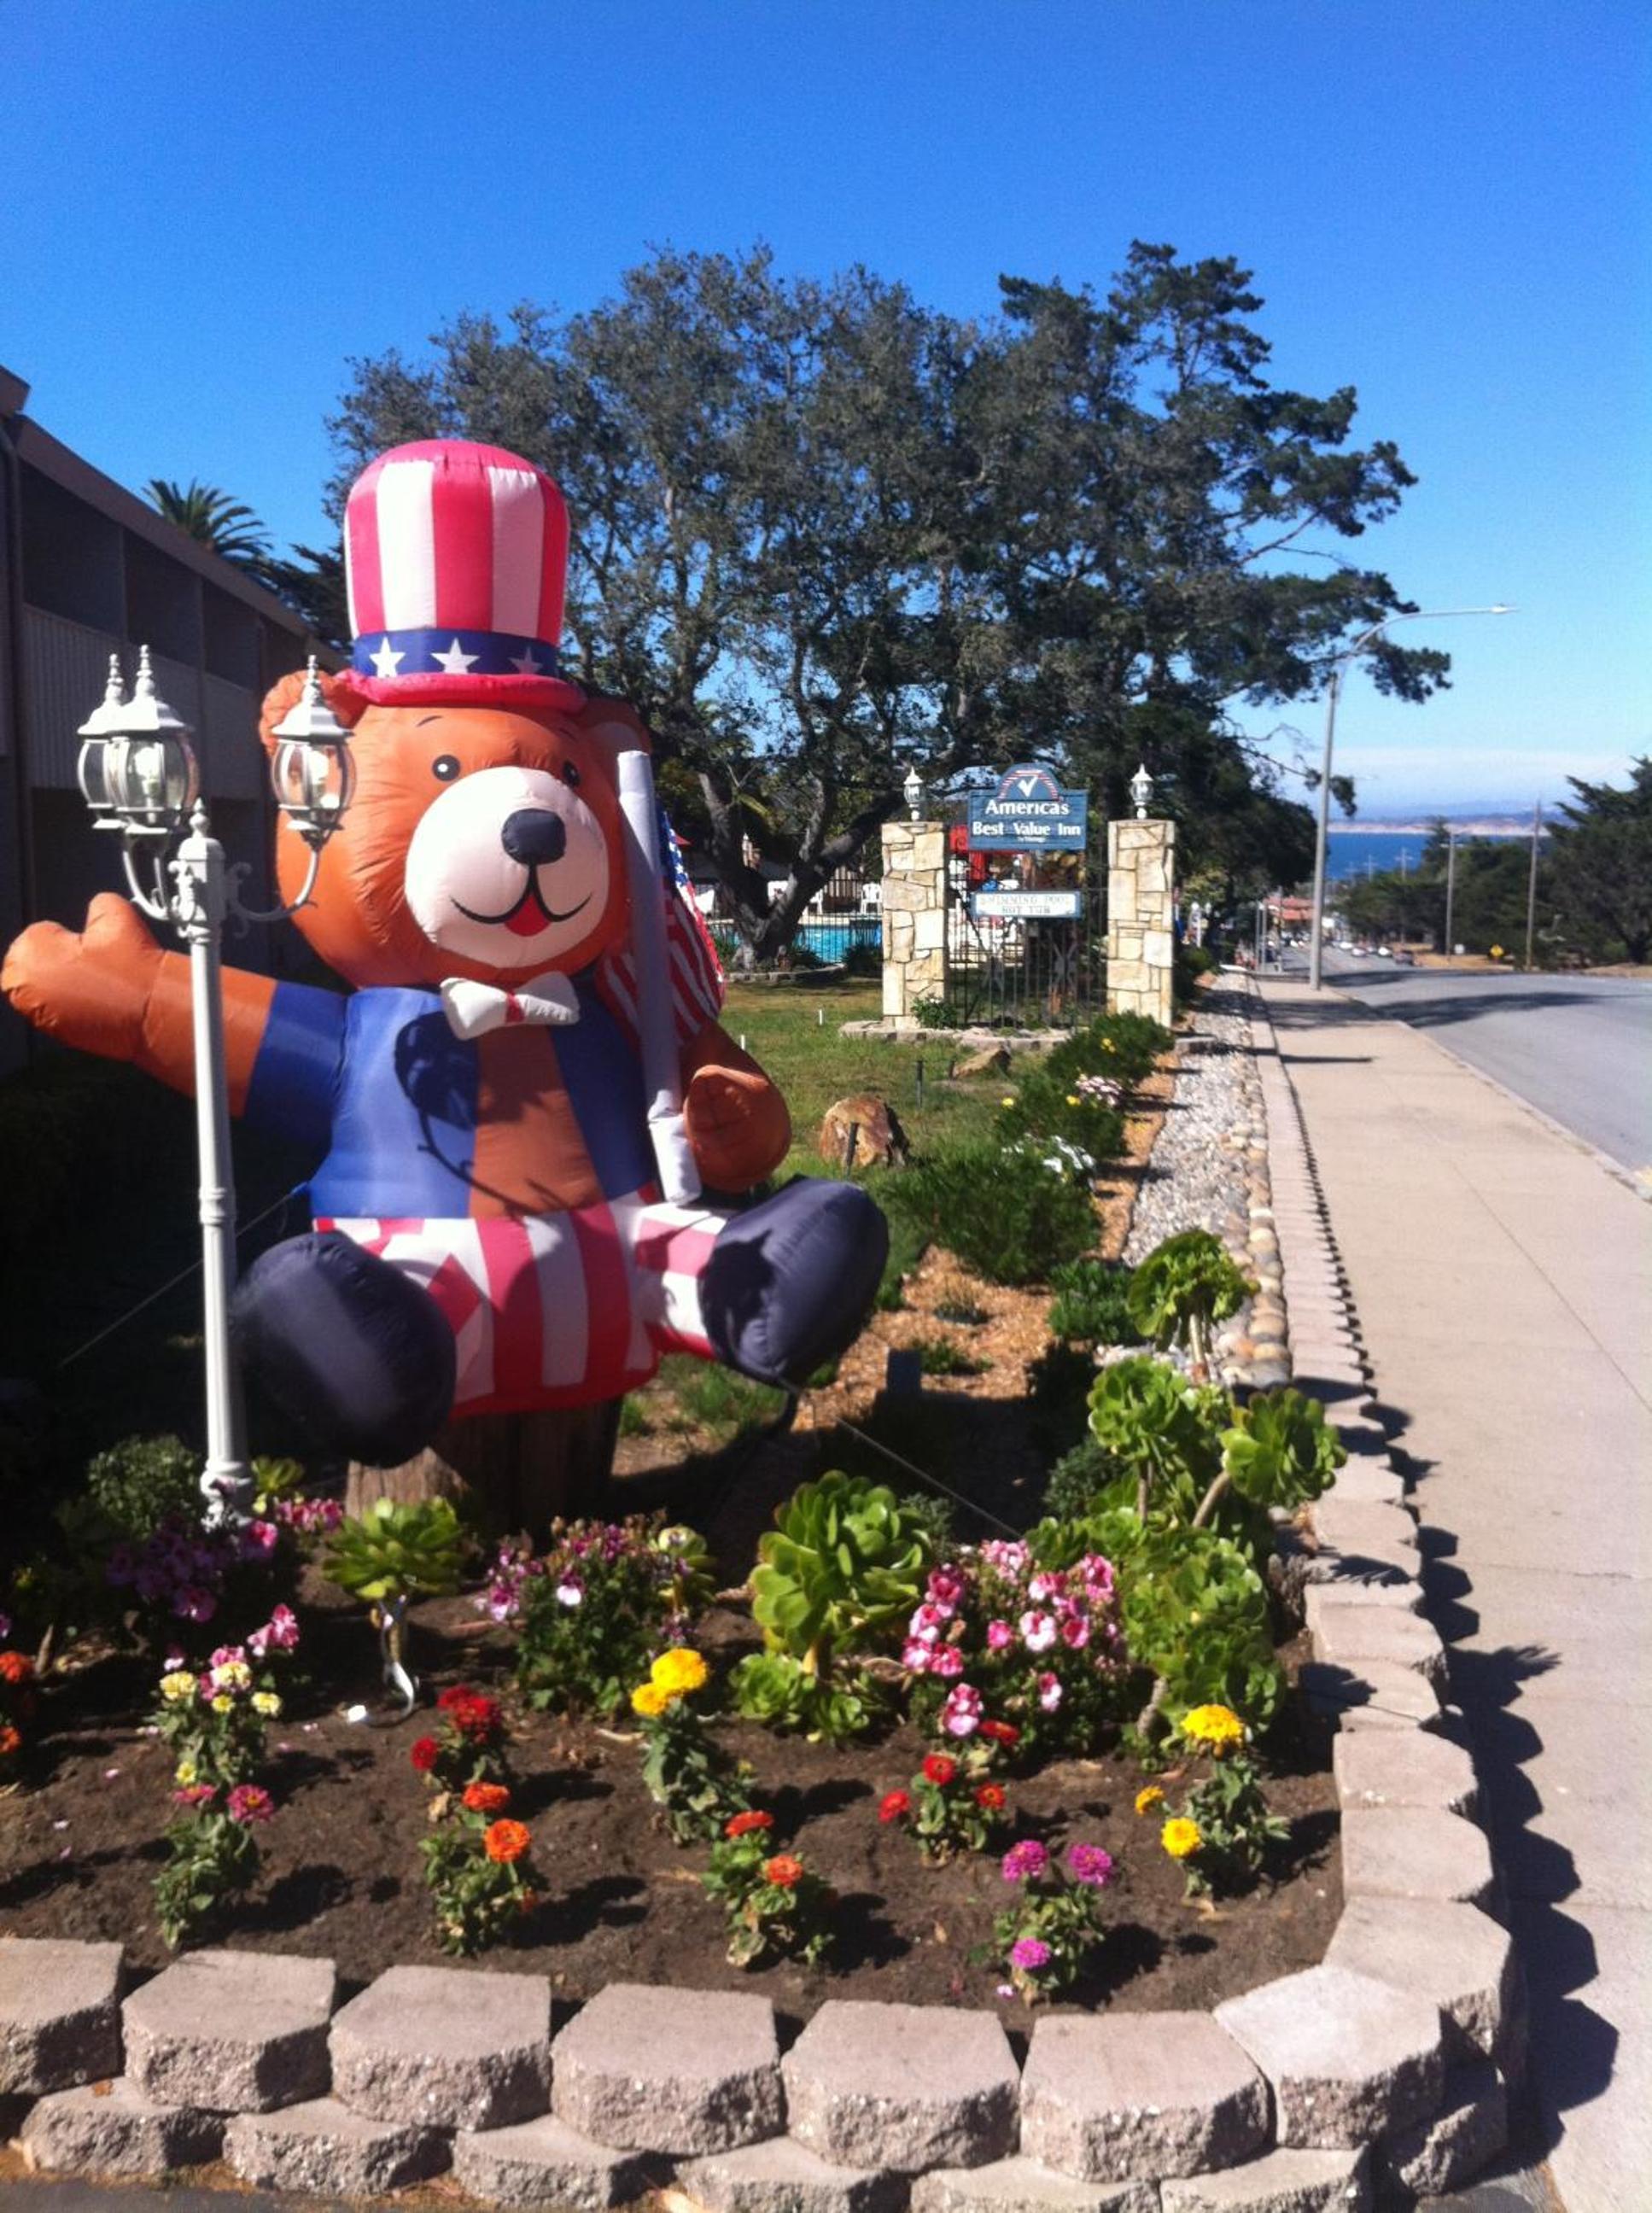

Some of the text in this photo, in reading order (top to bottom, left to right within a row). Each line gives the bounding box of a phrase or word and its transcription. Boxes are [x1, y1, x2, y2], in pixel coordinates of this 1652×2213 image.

[984, 799, 1070, 815] Americas
[972, 821, 1081, 836] Best Value Inn
